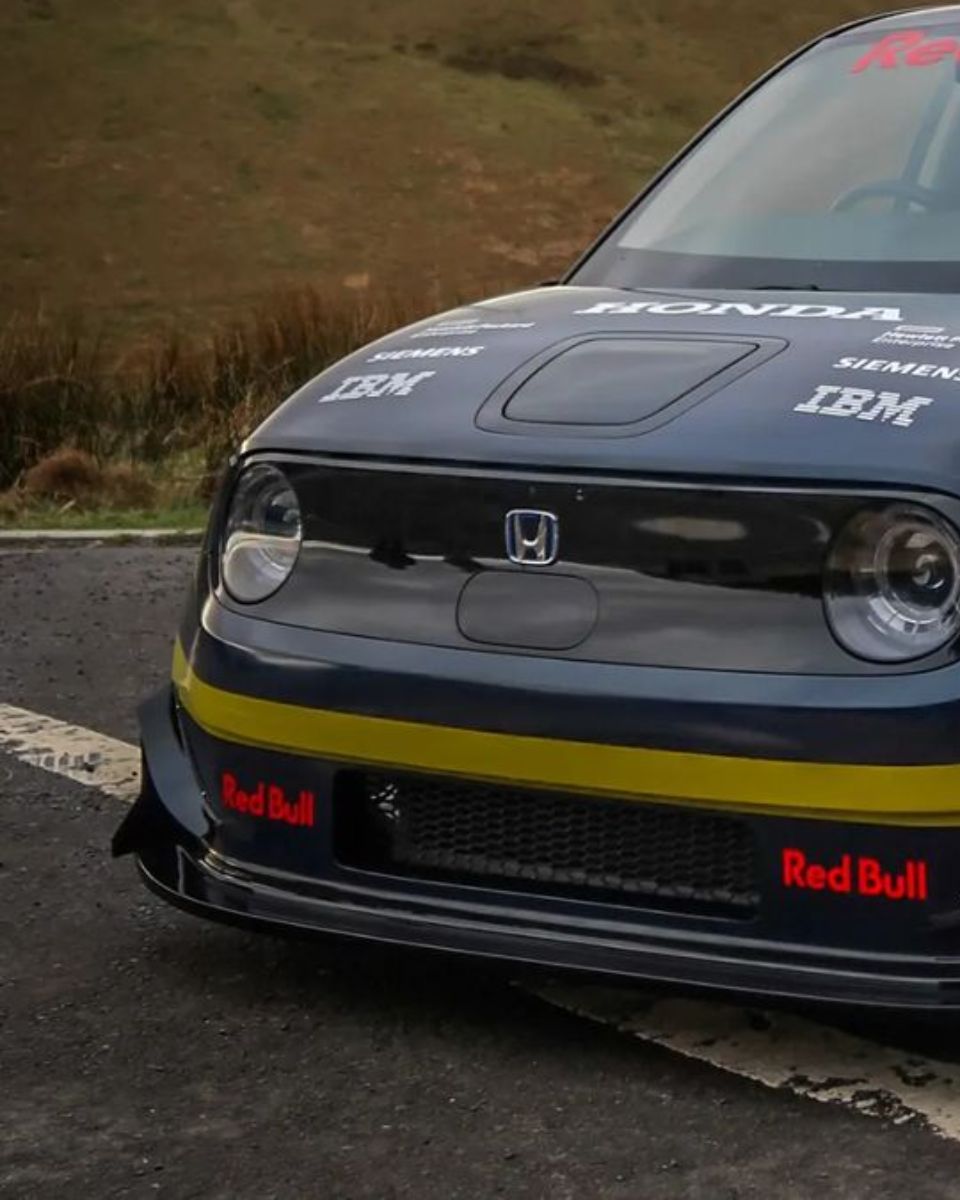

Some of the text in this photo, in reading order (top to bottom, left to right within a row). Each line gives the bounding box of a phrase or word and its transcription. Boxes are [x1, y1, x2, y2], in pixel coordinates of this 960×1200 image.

[574, 302, 903, 320] HONDA
[318, 371, 436, 402] IBM
[794, 384, 934, 427] IBM
[220, 772, 316, 827] Red Bull
[781, 847, 927, 900] Red Bull
